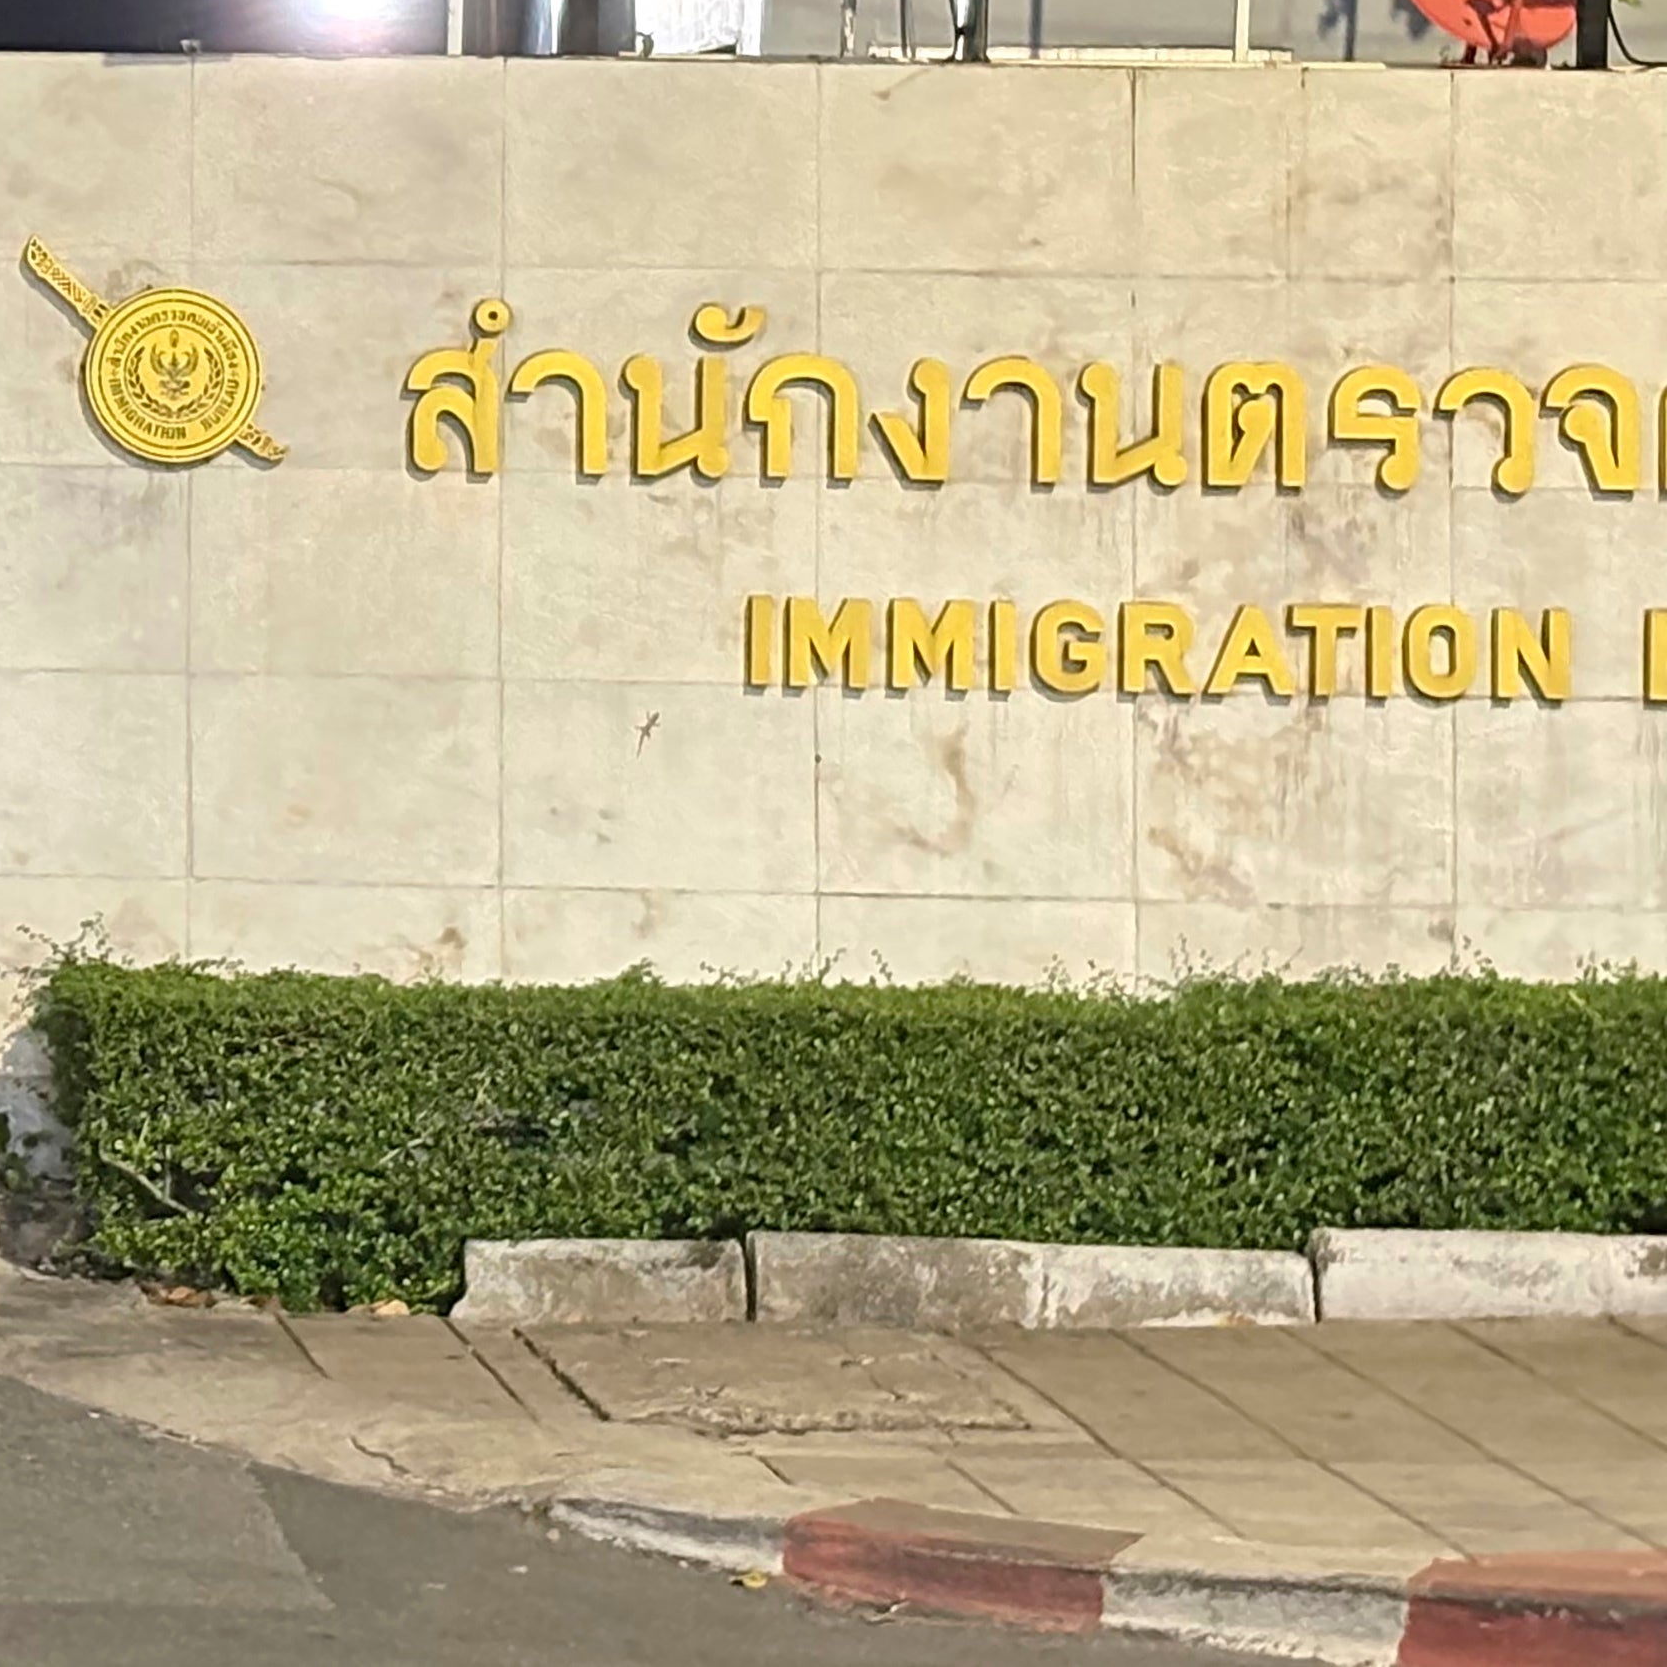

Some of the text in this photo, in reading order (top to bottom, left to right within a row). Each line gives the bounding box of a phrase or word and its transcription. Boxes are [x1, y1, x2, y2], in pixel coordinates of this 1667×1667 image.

[402, 297, 1667, 494] สำนักงานตรวจ
[746, 593, 1572, 702] IMMIGRATION
